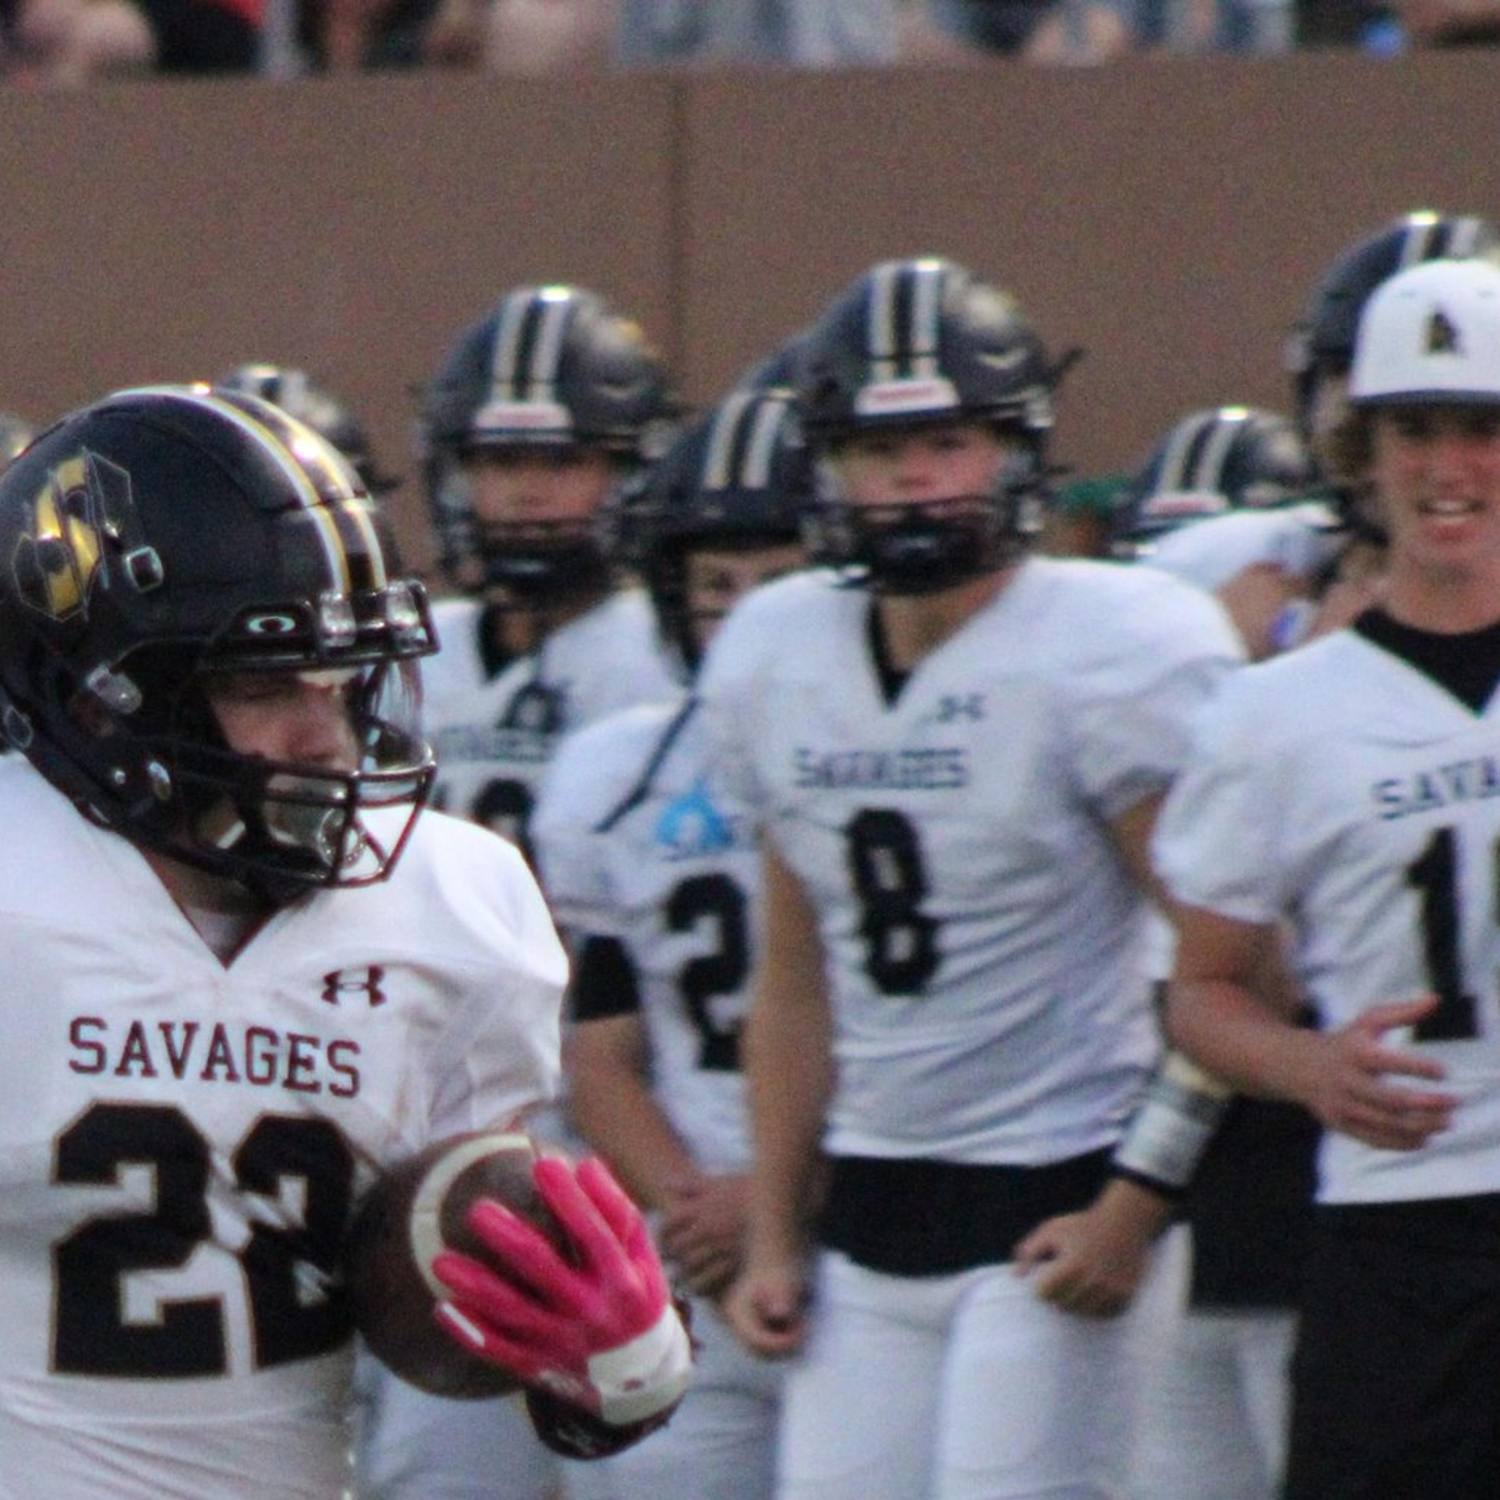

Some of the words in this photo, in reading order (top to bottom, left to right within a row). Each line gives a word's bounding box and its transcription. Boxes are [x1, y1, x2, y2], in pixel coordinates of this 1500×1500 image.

[846, 807, 941, 998] 8
[1403, 824, 1500, 1041] 1
[68, 1016, 361, 1099] SAVAGES
[47, 1096, 362, 1382] 22
